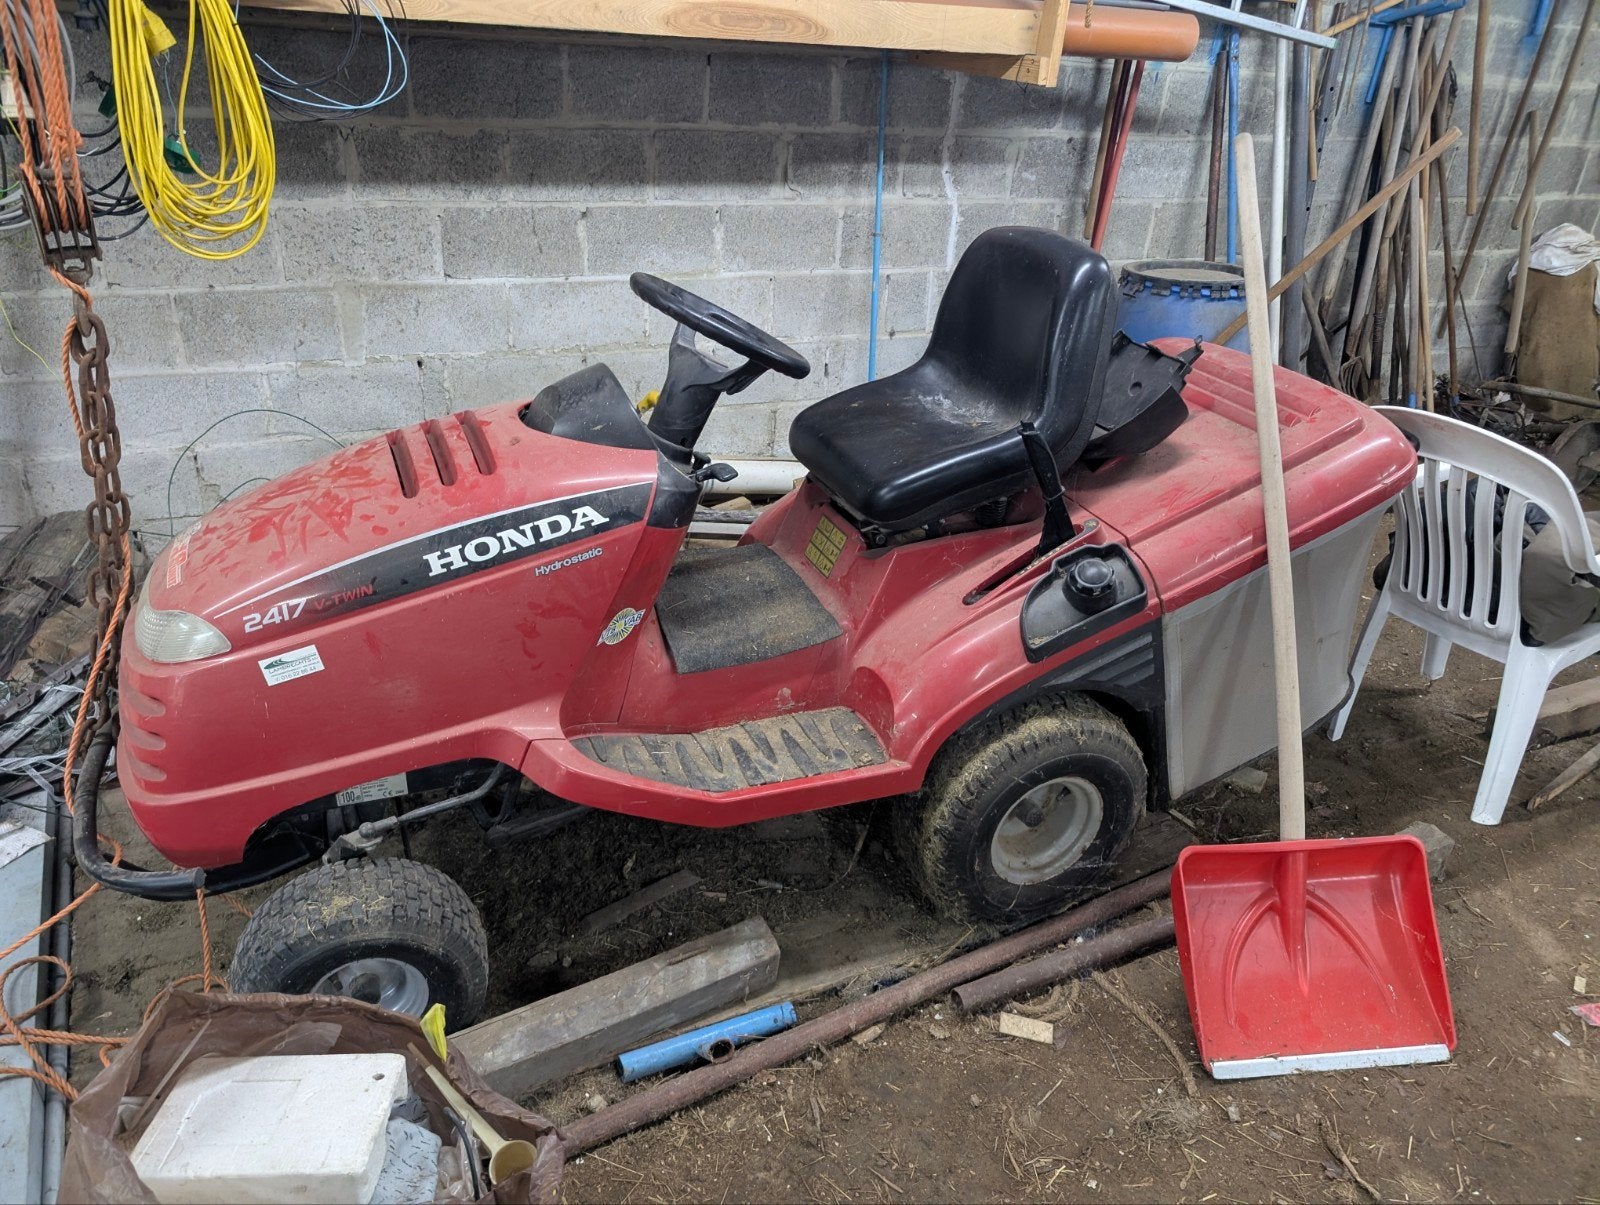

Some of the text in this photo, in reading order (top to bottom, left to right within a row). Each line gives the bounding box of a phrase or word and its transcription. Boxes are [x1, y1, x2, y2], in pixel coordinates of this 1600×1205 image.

[423, 505, 609, 577] HONDA
[535, 547, 603, 576] Hydrostatic
[242, 583, 374, 633] 2417 V-TWIN
[624, 612, 643, 627] VAB
[268, 658, 312, 674] LAMBRECHTS
[341, 790, 355, 803] 100
